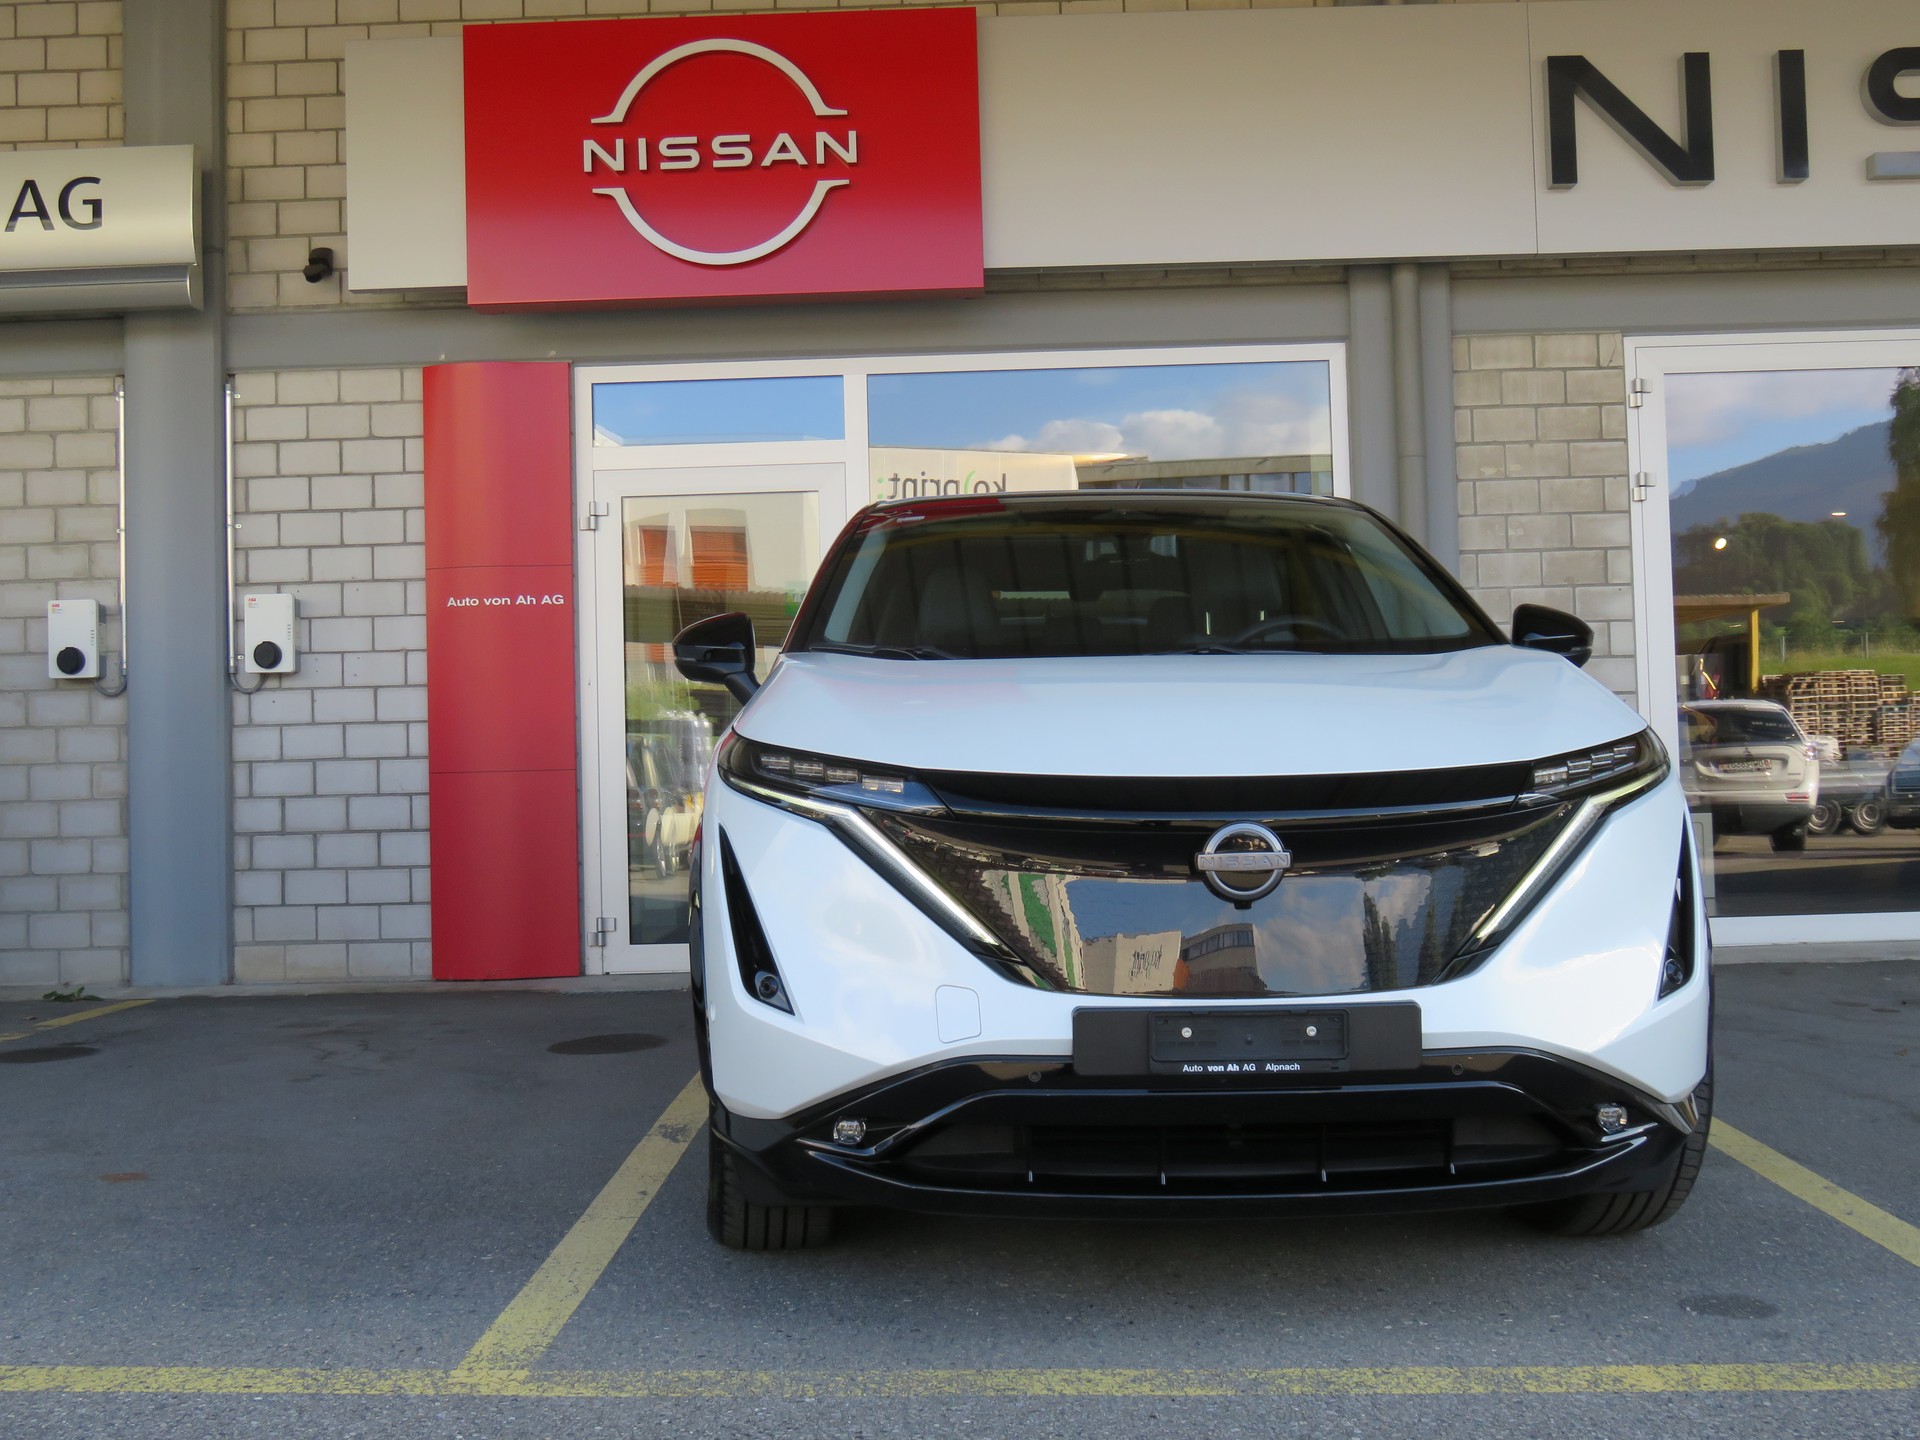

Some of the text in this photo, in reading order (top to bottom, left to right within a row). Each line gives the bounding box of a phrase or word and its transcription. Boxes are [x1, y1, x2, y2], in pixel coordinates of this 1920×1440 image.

[582, 131, 859, 173] NISSAN
[4, 177, 103, 232] AG
[447, 594, 564, 607] Auto von Ah AG
[1200, 855, 1289, 868] NISSAN
[1182, 1064, 1203, 1072] Auto
[1226, 1063, 1240, 1072] Ah
[1242, 1063, 1256, 1071] AG
[1265, 1062, 1300, 1072] Alpnach
